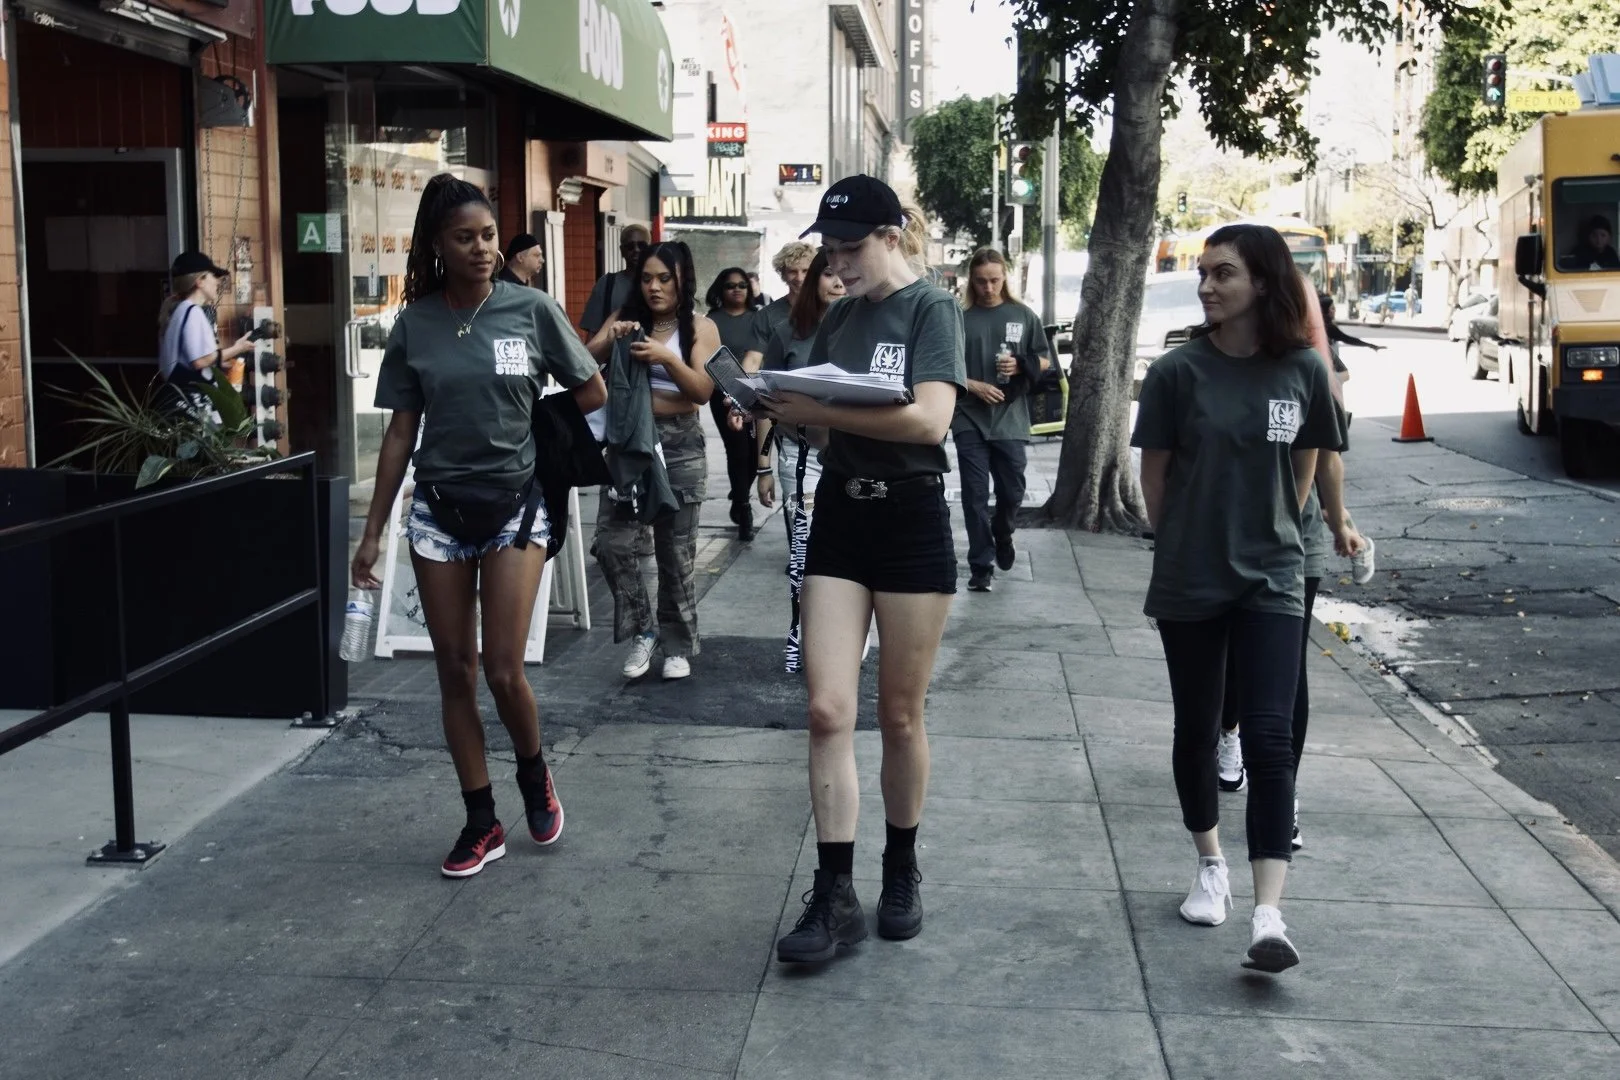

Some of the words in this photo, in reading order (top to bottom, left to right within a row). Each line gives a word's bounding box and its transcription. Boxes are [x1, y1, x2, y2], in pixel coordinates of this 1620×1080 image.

[579, 0, 623, 90] FOOD
[1515, 96, 1540, 107] PED
[1547, 96, 1576, 106] XING
[302, 221, 322, 245] A
